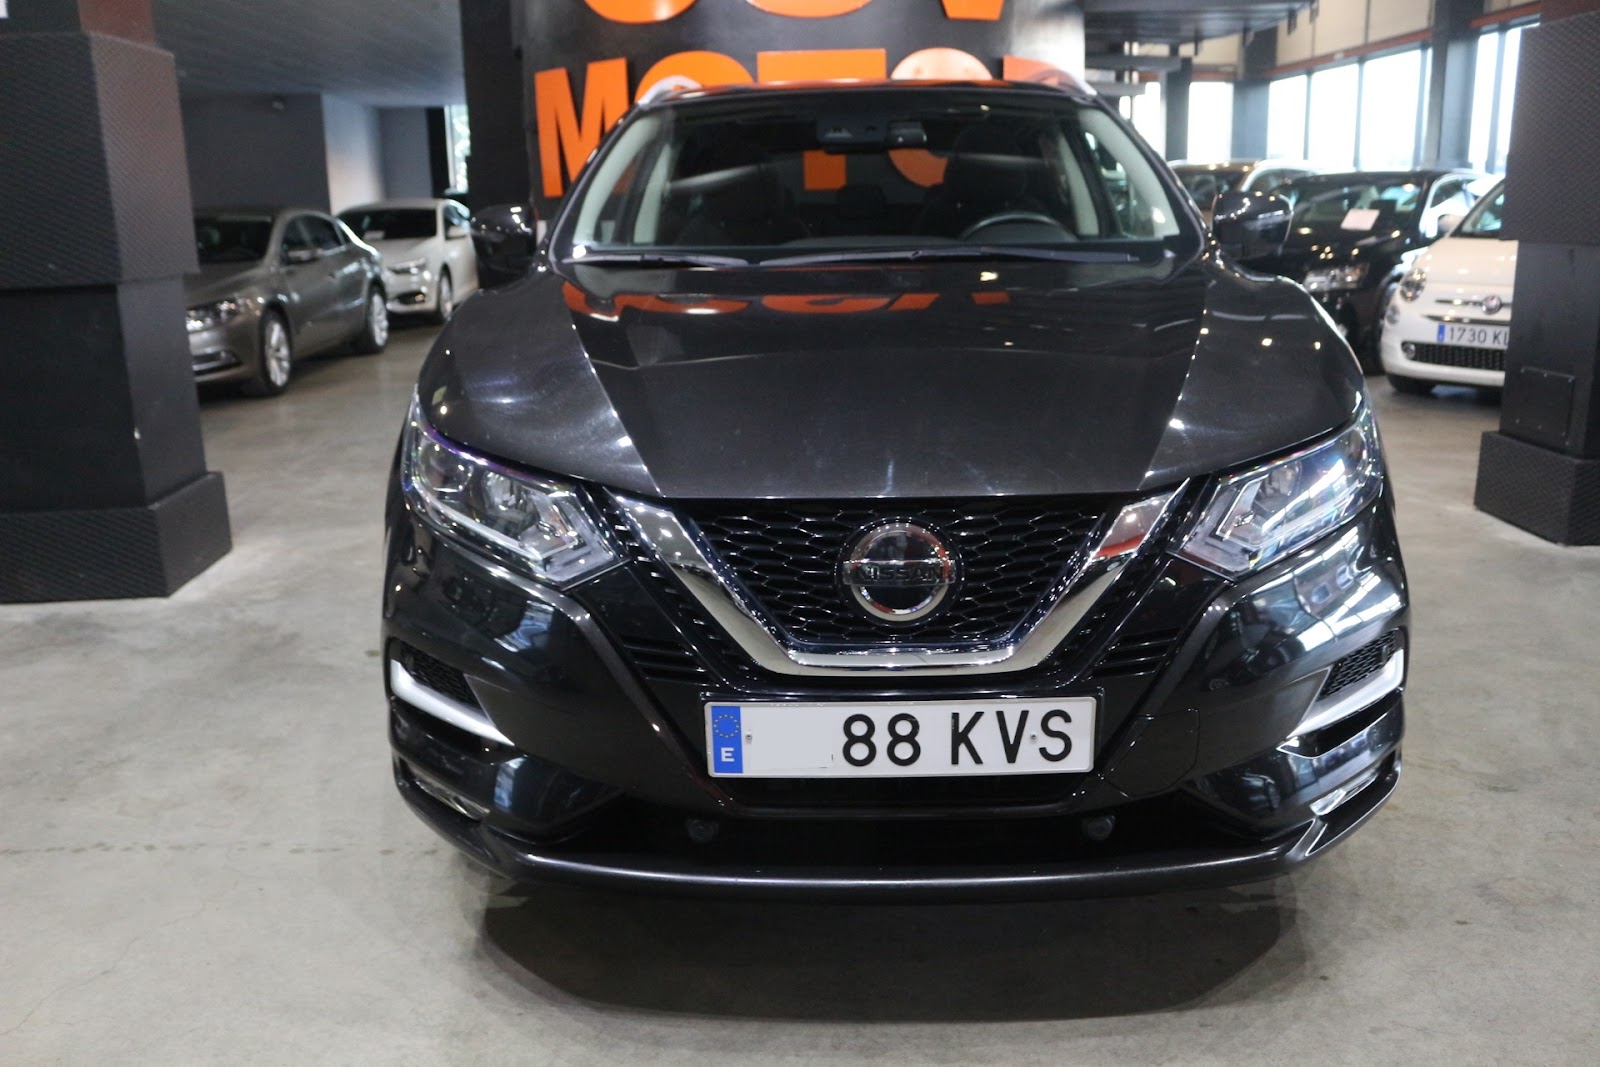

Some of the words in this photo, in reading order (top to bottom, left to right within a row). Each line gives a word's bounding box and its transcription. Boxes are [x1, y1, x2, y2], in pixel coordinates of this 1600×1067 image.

[1449, 327, 1487, 344] 1730
[856, 567, 946, 582] NISSAN
[720, 747, 735, 762] E
[842, 713, 921, 766] 88
[951, 709, 1073, 765] KVS
